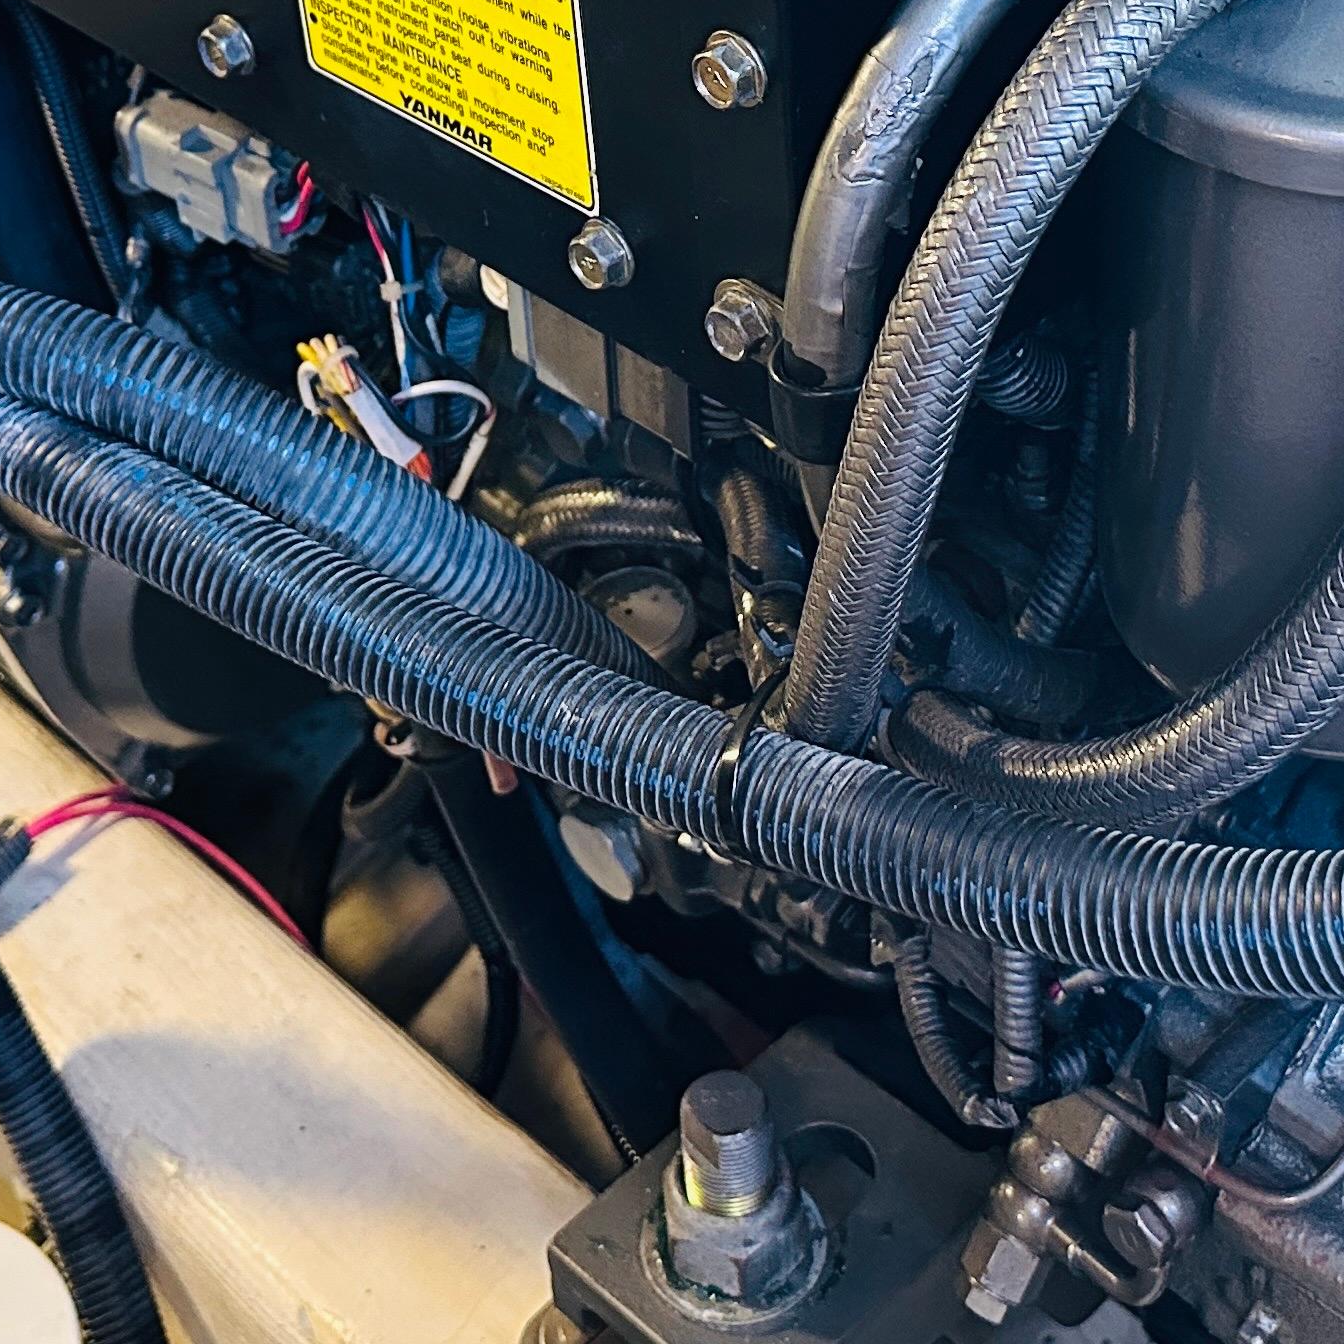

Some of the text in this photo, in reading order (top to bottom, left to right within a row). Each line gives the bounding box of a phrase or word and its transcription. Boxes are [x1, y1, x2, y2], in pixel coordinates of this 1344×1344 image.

[375, 10, 391, 28] the
[450, 50, 472, 68] seat
[476, 62, 510, 91] during
[381, 31, 462, 84] MAINTENANCE
[410, 0, 428, 18] and
[433, 12, 463, 34] watch
[468, 29, 485, 46] out
[489, 36, 504, 55] for
[510, 50, 552, 81] warning
[498, 29, 550, 62] vibrations
[519, 8, 547, 30] while
[552, 22, 570, 40] the
[320, 16, 554, 146] Stop the engine and allow all movement stop
[320, 32, 546, 156] completely before conducting inspection and
[399, 90, 492, 152] YANMAR
